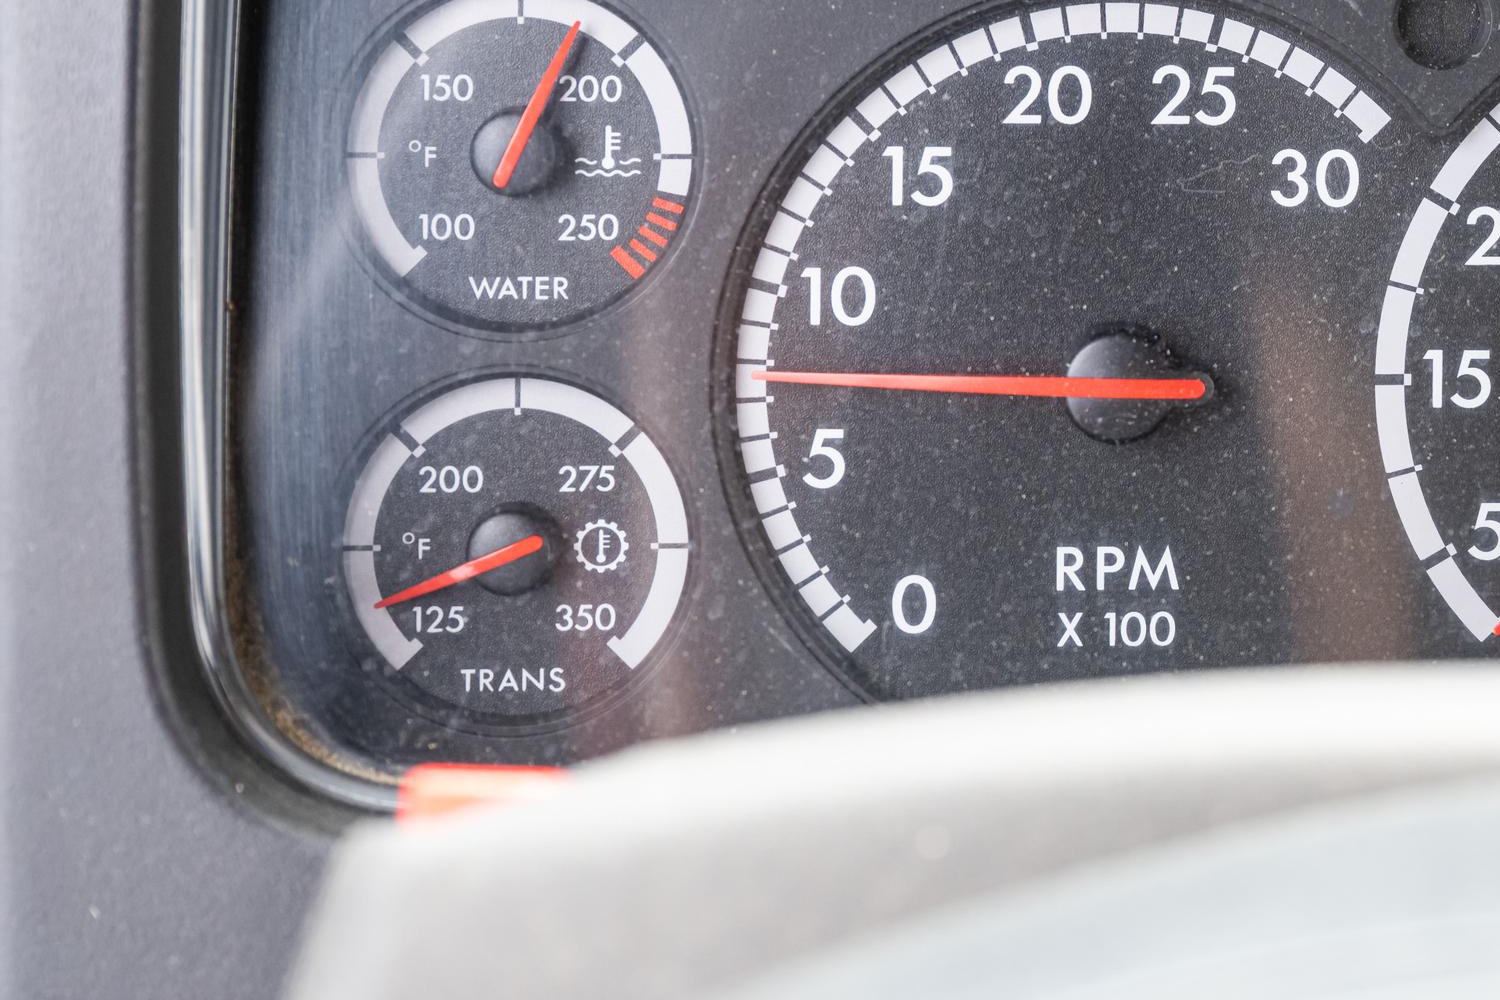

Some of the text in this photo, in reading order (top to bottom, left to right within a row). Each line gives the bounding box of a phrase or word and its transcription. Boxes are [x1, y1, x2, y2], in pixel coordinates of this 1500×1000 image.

[419, 73, 474, 102] 150
[559, 74, 623, 103] 200
[1001, 64, 1093, 125] 20
[1150, 64, 1237, 127] 25
[881, 145, 954, 207] 15
[1270, 148, 1360, 208] 30
[418, 213, 476, 241] 100
[557, 213, 619, 242] 250
[468, 275, 569, 301] WATER
[800, 265, 876, 327] 10
[1422, 349, 1492, 409] 15
[802, 428, 846, 490] 5
[418, 465, 484, 494] 200
[558, 464, 616, 493] 275
[1056, 544, 1180, 592] RPM
[412, 605, 464, 634] 125
[555, 602, 617, 632] 350
[891, 574, 937, 635] 0
[1056, 610, 1176, 648] X 100
[460, 667, 567, 693] TRANS
